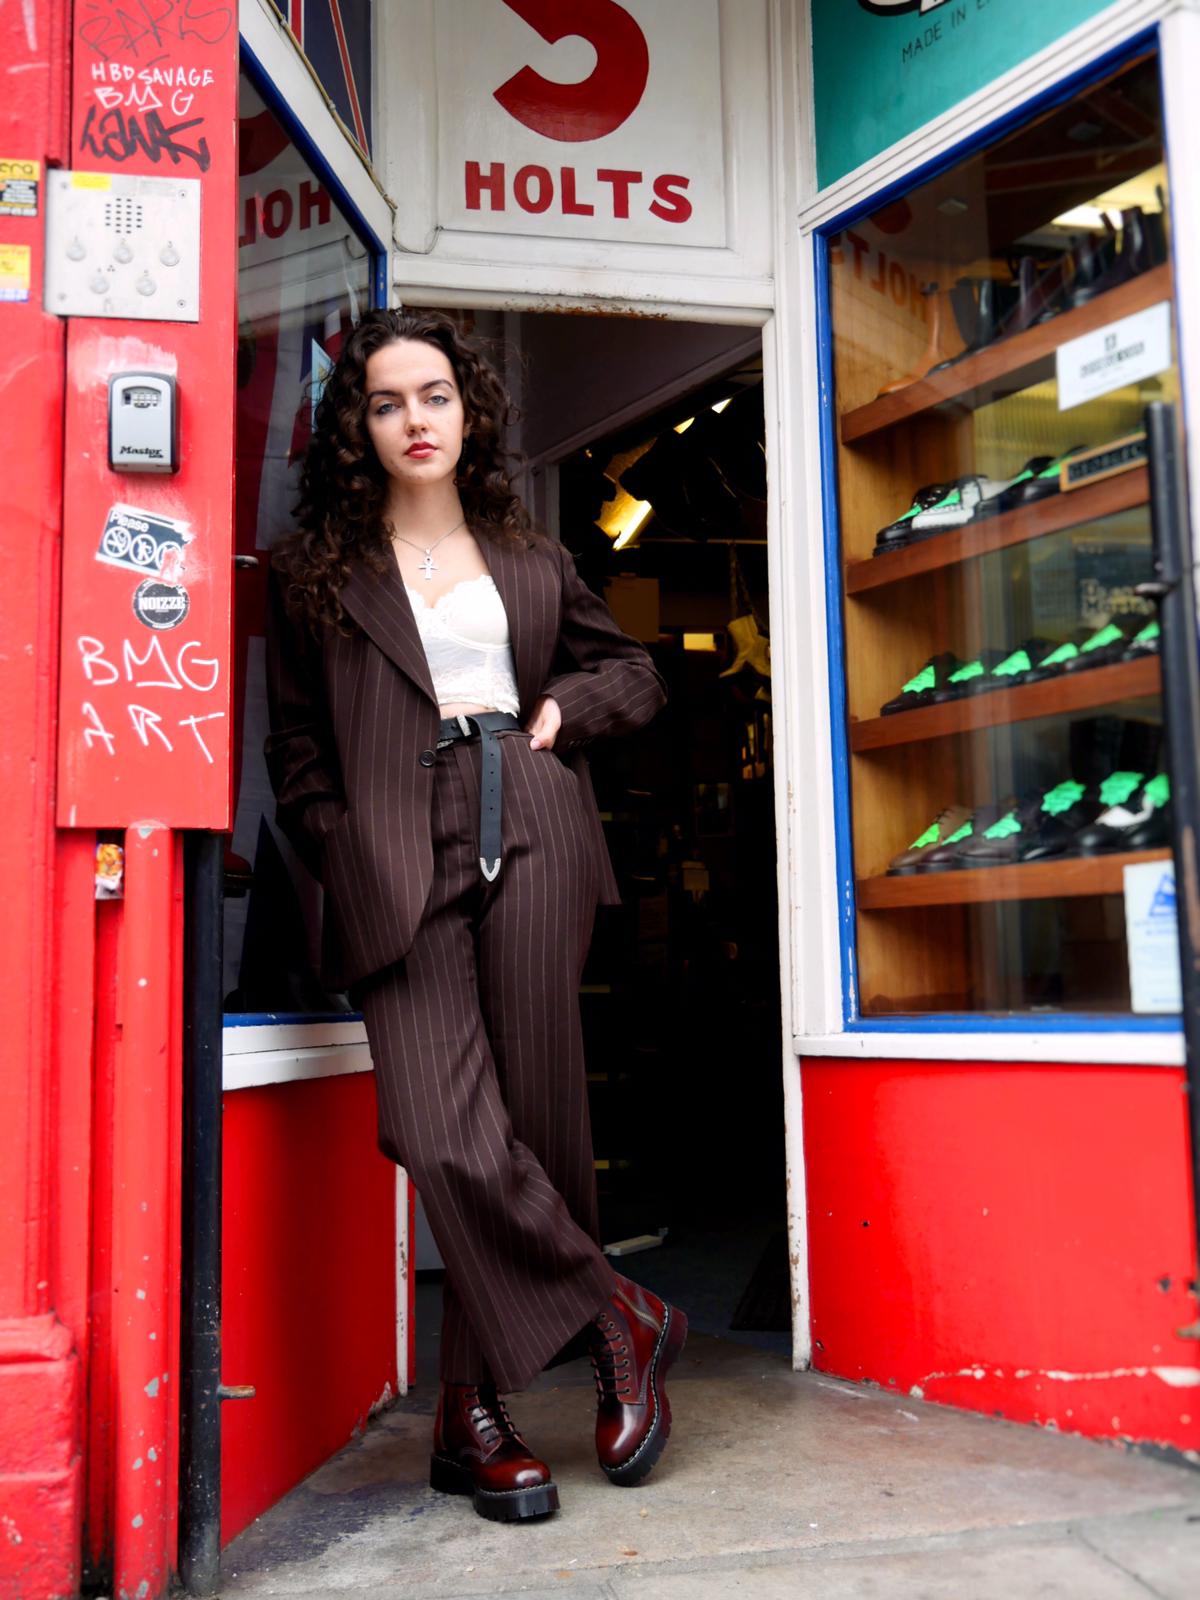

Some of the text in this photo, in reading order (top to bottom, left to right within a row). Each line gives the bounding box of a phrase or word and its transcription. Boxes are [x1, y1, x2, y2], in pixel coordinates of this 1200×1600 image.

[902, 21, 943, 63] MADE
[951, 4, 967, 28] IN
[91, 62, 215, 87] HBD SAVAGE
[94, 83, 194, 116] BMG
[465, 161, 693, 223] HOLTS
[119, 446, 163, 456] Master
[110, 510, 150, 532] Please
[78, 635, 219, 691] BMG
[82, 701, 225, 764] ART
